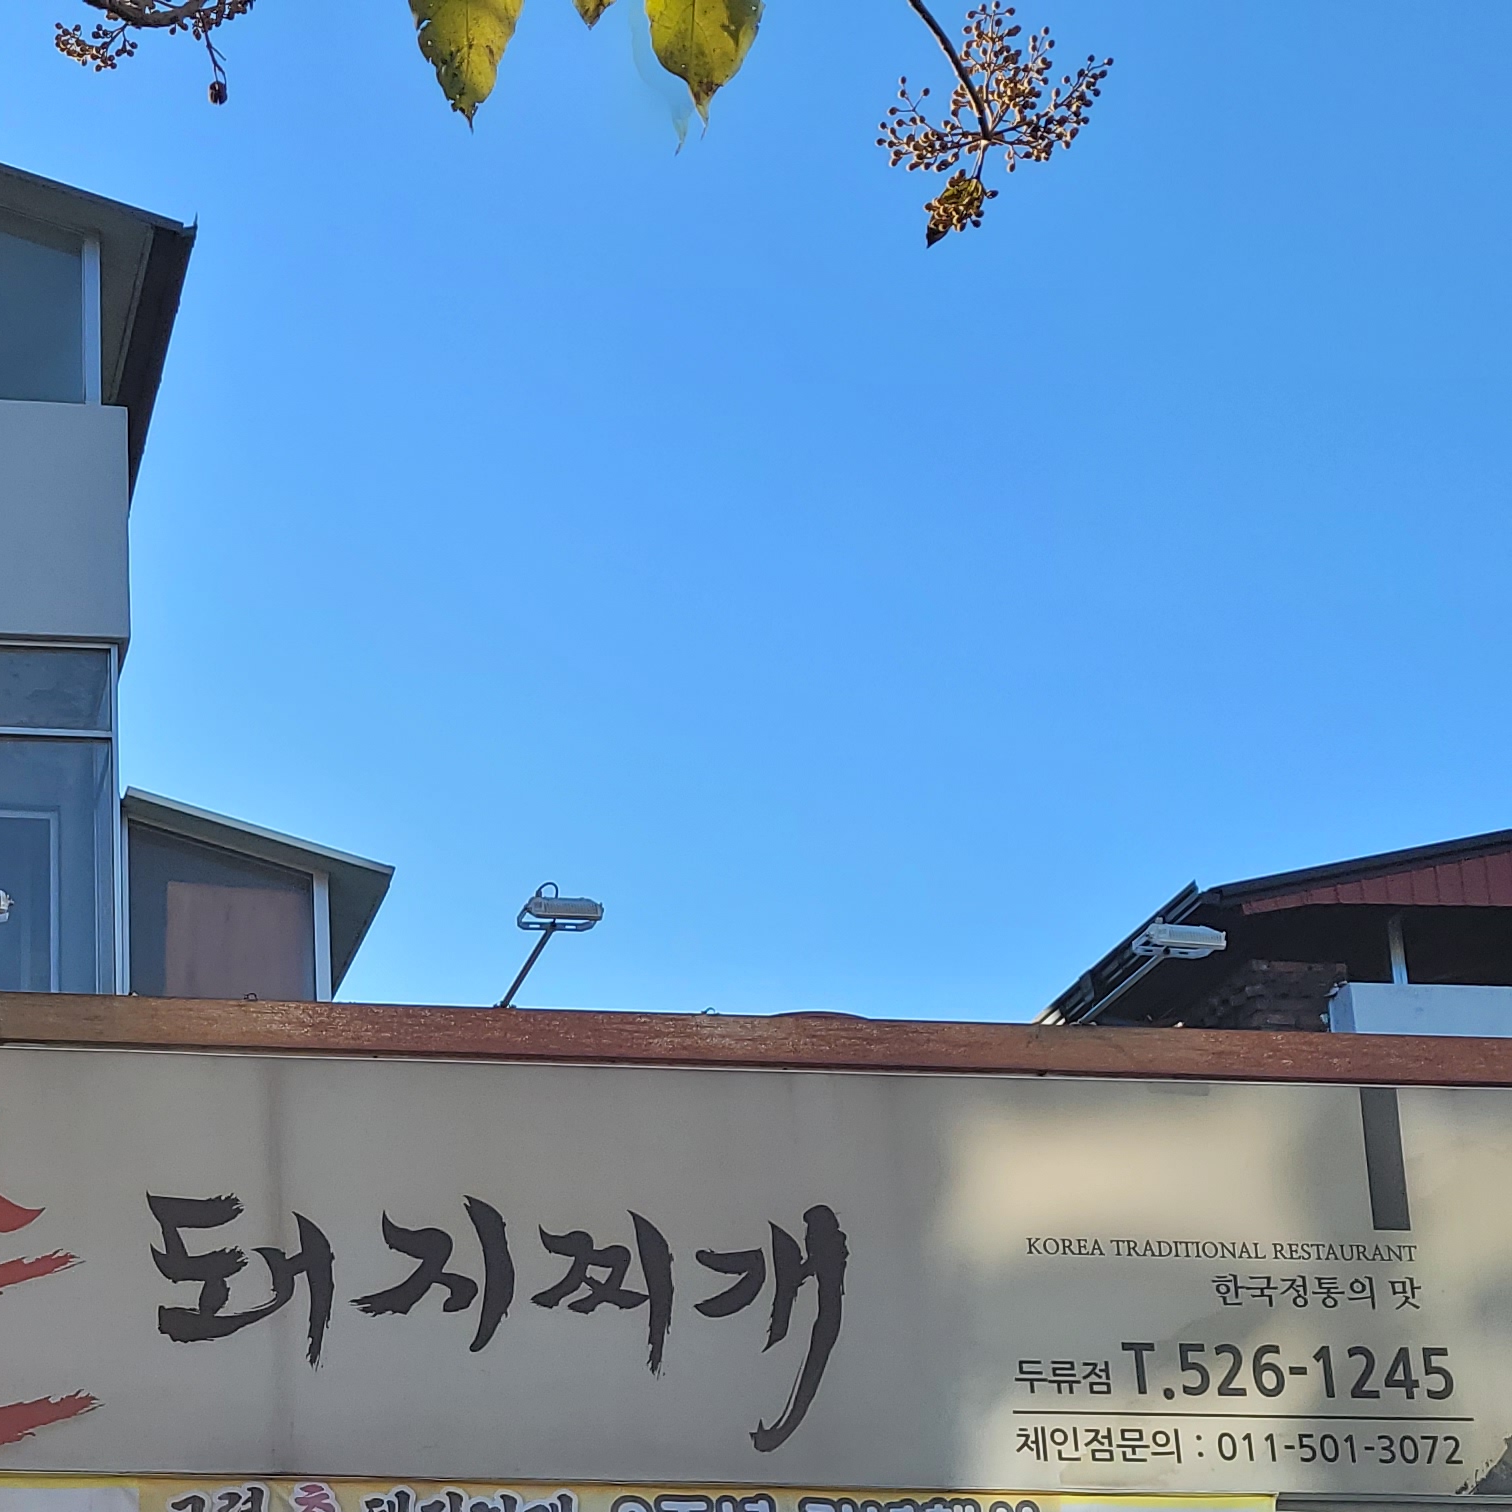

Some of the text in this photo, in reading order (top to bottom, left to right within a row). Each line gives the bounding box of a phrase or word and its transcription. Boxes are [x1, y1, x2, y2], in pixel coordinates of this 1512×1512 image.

[1026, 1237, 1417, 1263] KOREA TRADITIONAL RESTAURANT
[1212, 1274, 1421, 1310] 한국정통의 맛
[147, 1190, 849, 1453] 돼지찌개
[1014, 1341, 1455, 1401] 두류점 T.526-1245
[1217, 1432, 1464, 1465] 011-501-3072
